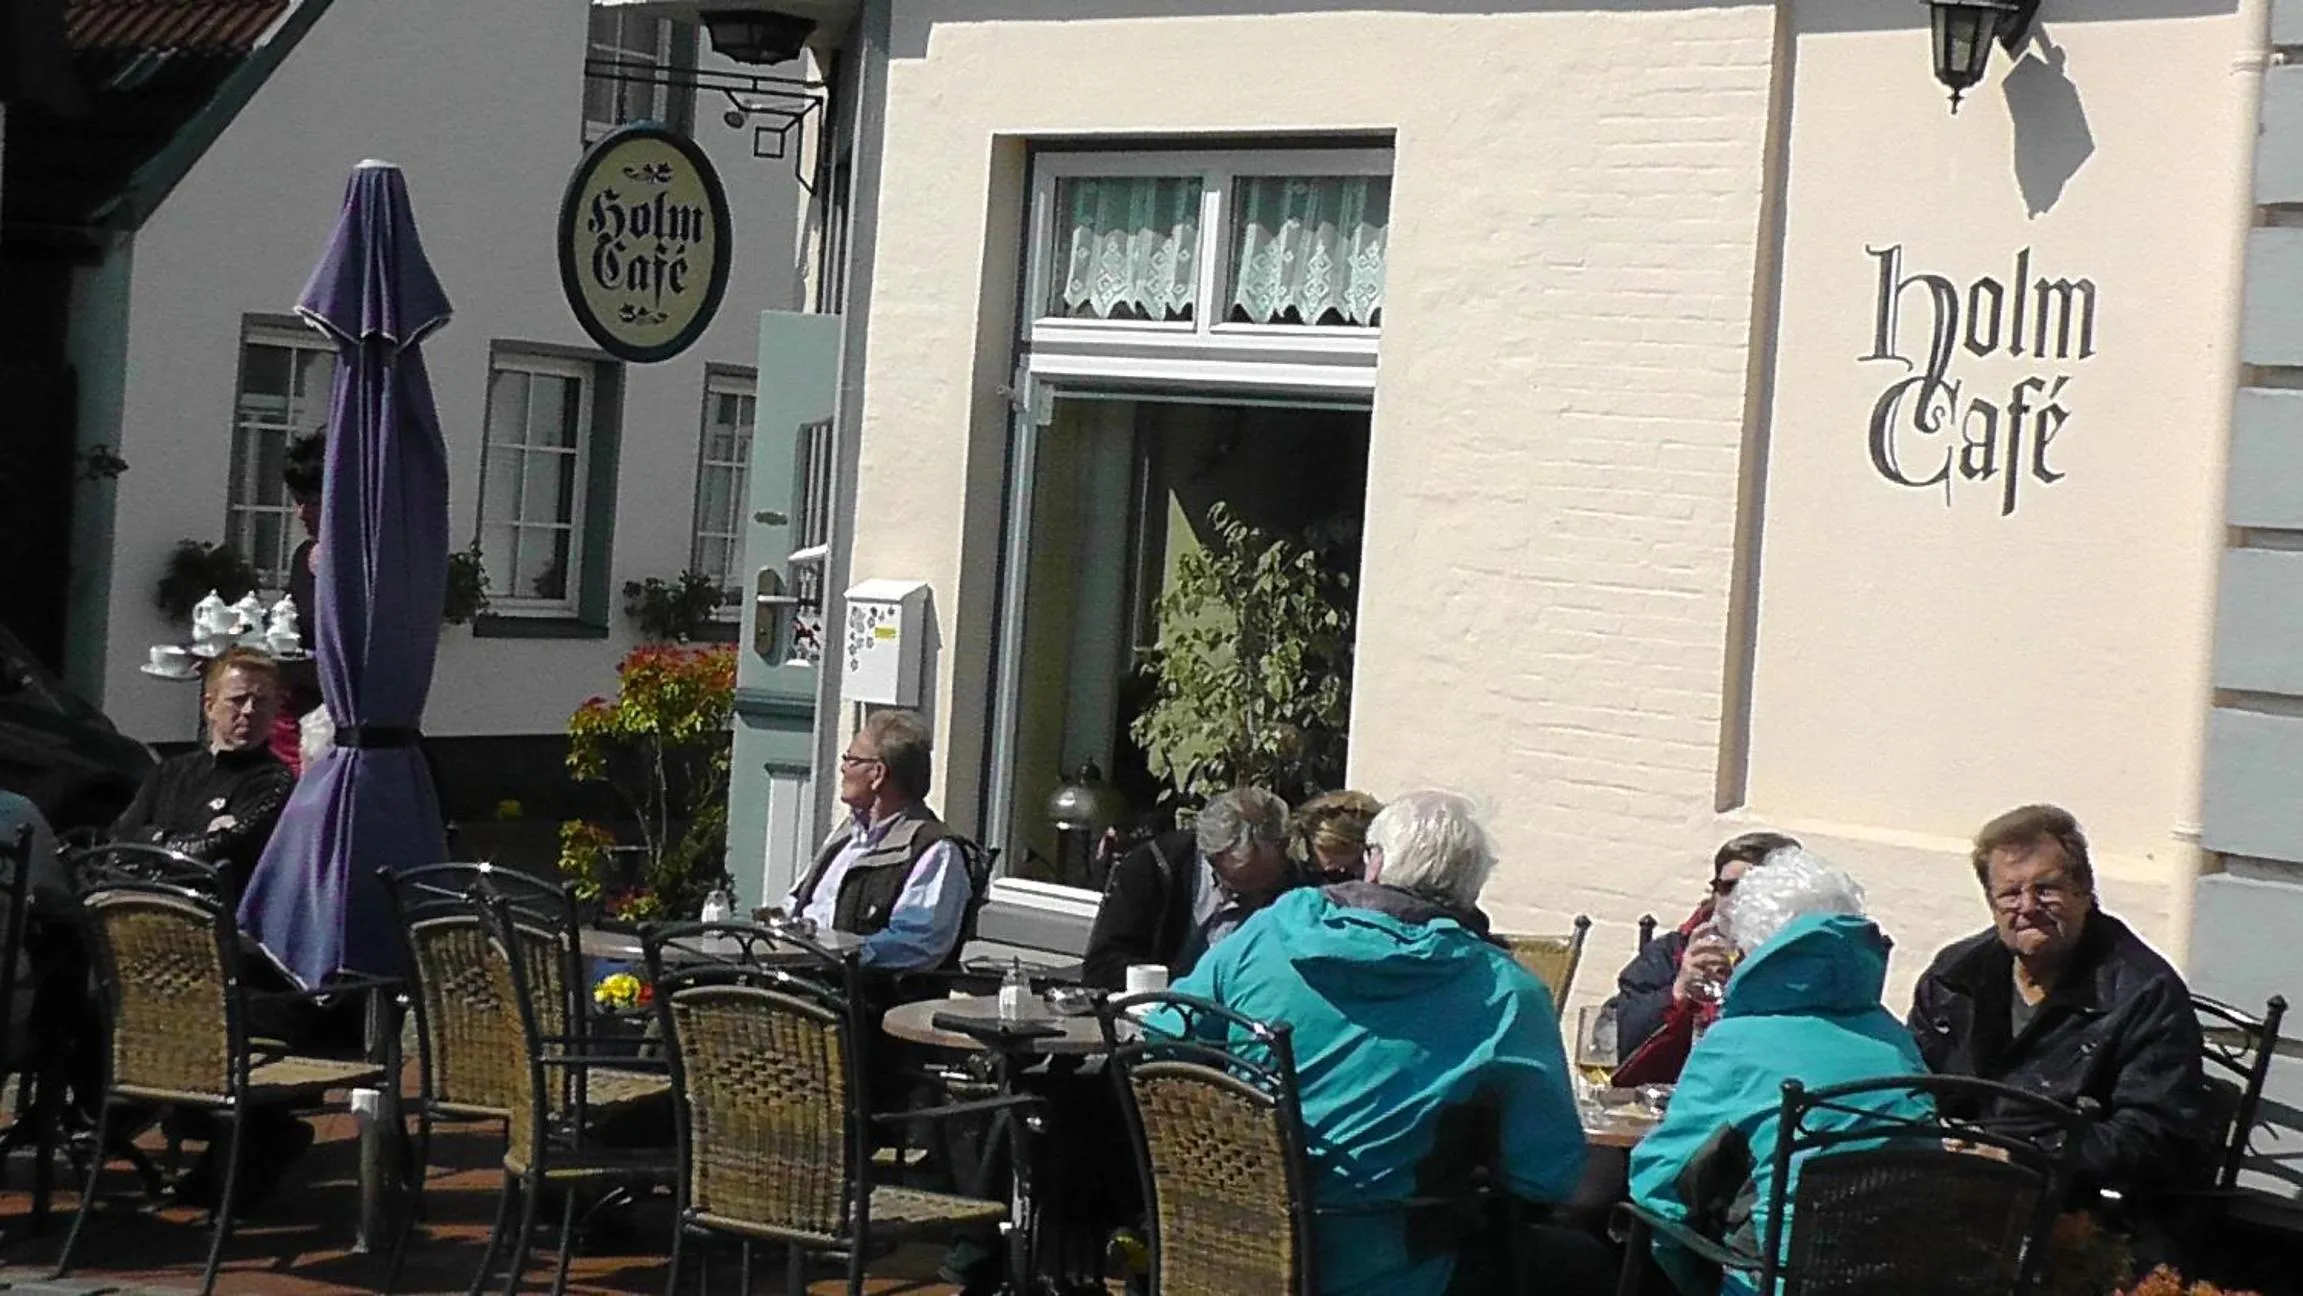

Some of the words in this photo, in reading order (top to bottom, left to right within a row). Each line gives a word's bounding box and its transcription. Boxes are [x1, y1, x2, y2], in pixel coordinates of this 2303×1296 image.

[588, 188, 704, 244] Holm
[592, 232, 689, 309] Café
[1868, 375, 2072, 517] Café
